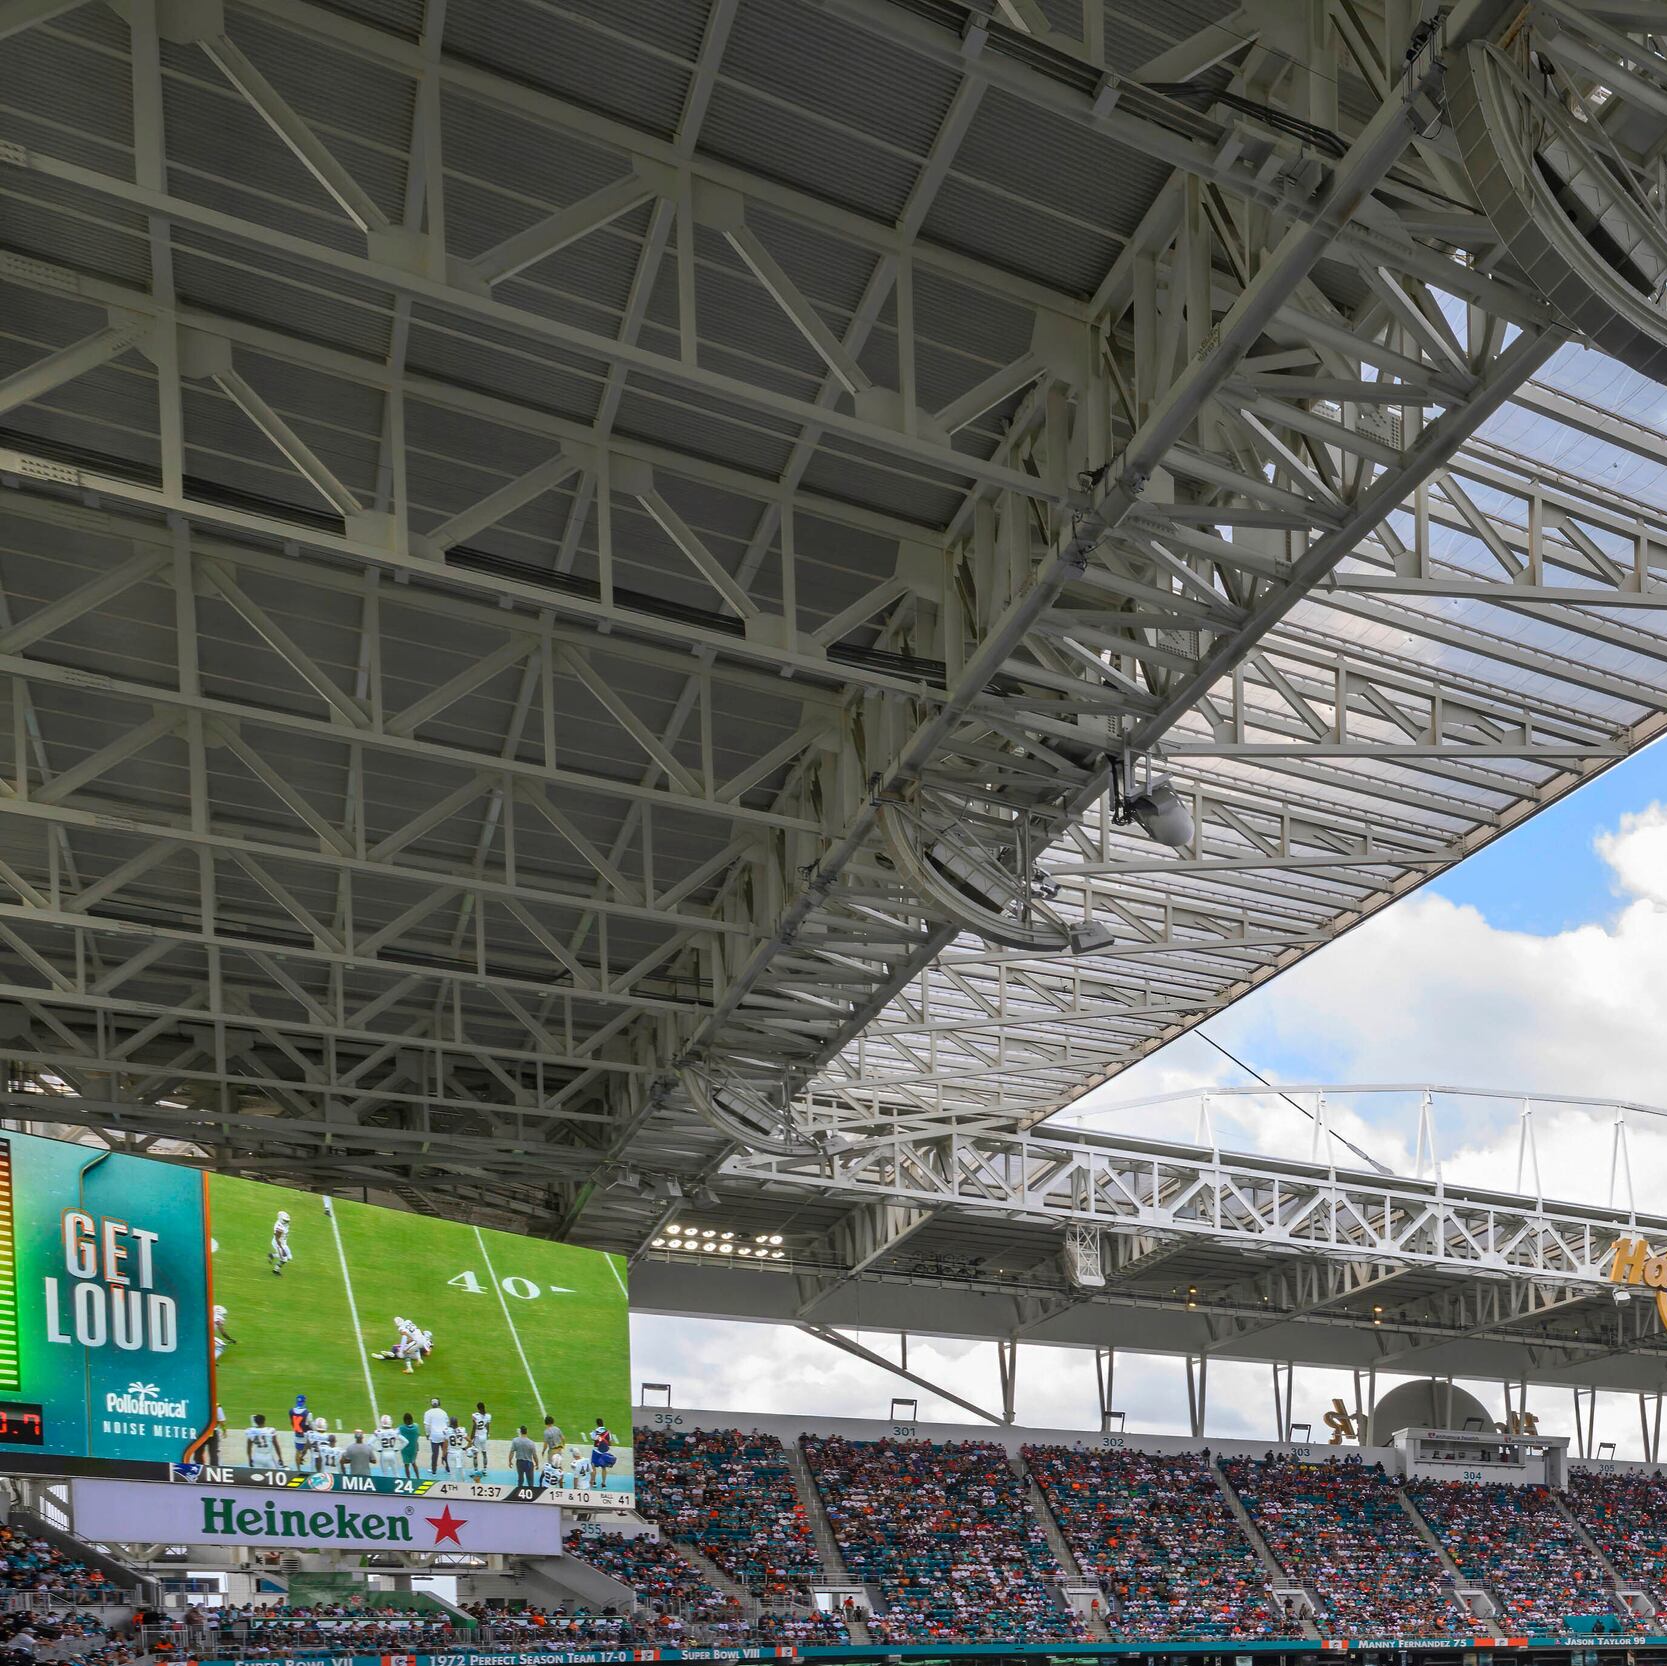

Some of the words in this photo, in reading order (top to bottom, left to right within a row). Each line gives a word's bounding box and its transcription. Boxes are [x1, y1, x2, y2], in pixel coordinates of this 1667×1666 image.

[63, 1208, 159, 1290] GET
[447, 1270, 541, 1300] 40
[45, 1276, 177, 1353] LOUD
[654, 1412, 684, 1426] 356
[103, 1420, 146, 1437] NOISE
[153, 1423, 198, 1441] METER
[893, 1426, 916, 1437] 301
[1102, 1436, 1125, 1447] 302
[206, 1466, 235, 1484] NE
[264, 1470, 288, 1487] 10
[342, 1475, 377, 1492] MIA
[394, 1479, 415, 1494] 24
[440, 1483, 459, 1495] 4TH
[470, 1486, 502, 1499] 12:37
[517, 1488, 534, 1500] 40
[577, 1492, 590, 1503] 10
[618, 1494, 631, 1506] 41
[200, 1496, 414, 1542] Heineken
[580, 1522, 603, 1535] 355
[1358, 1639, 1396, 1649] MANNY
[1398, 1639, 1452, 1649] FERNANDEZ
[1565, 1637, 1594, 1646] JASON
[1596, 1636, 1632, 1646] TAYLOR
[1633, 1636, 1646, 1645] 99
[469, 1653, 516, 1666] PERFECT
[518, 1652, 566, 1665] SEASON
[567, 1651, 596, 1664] TEAM
[600, 1650, 627, 1663] 17-0
[681, 1649, 711, 1660] SUPER
[713, 1648, 740, 1660] BOWL
